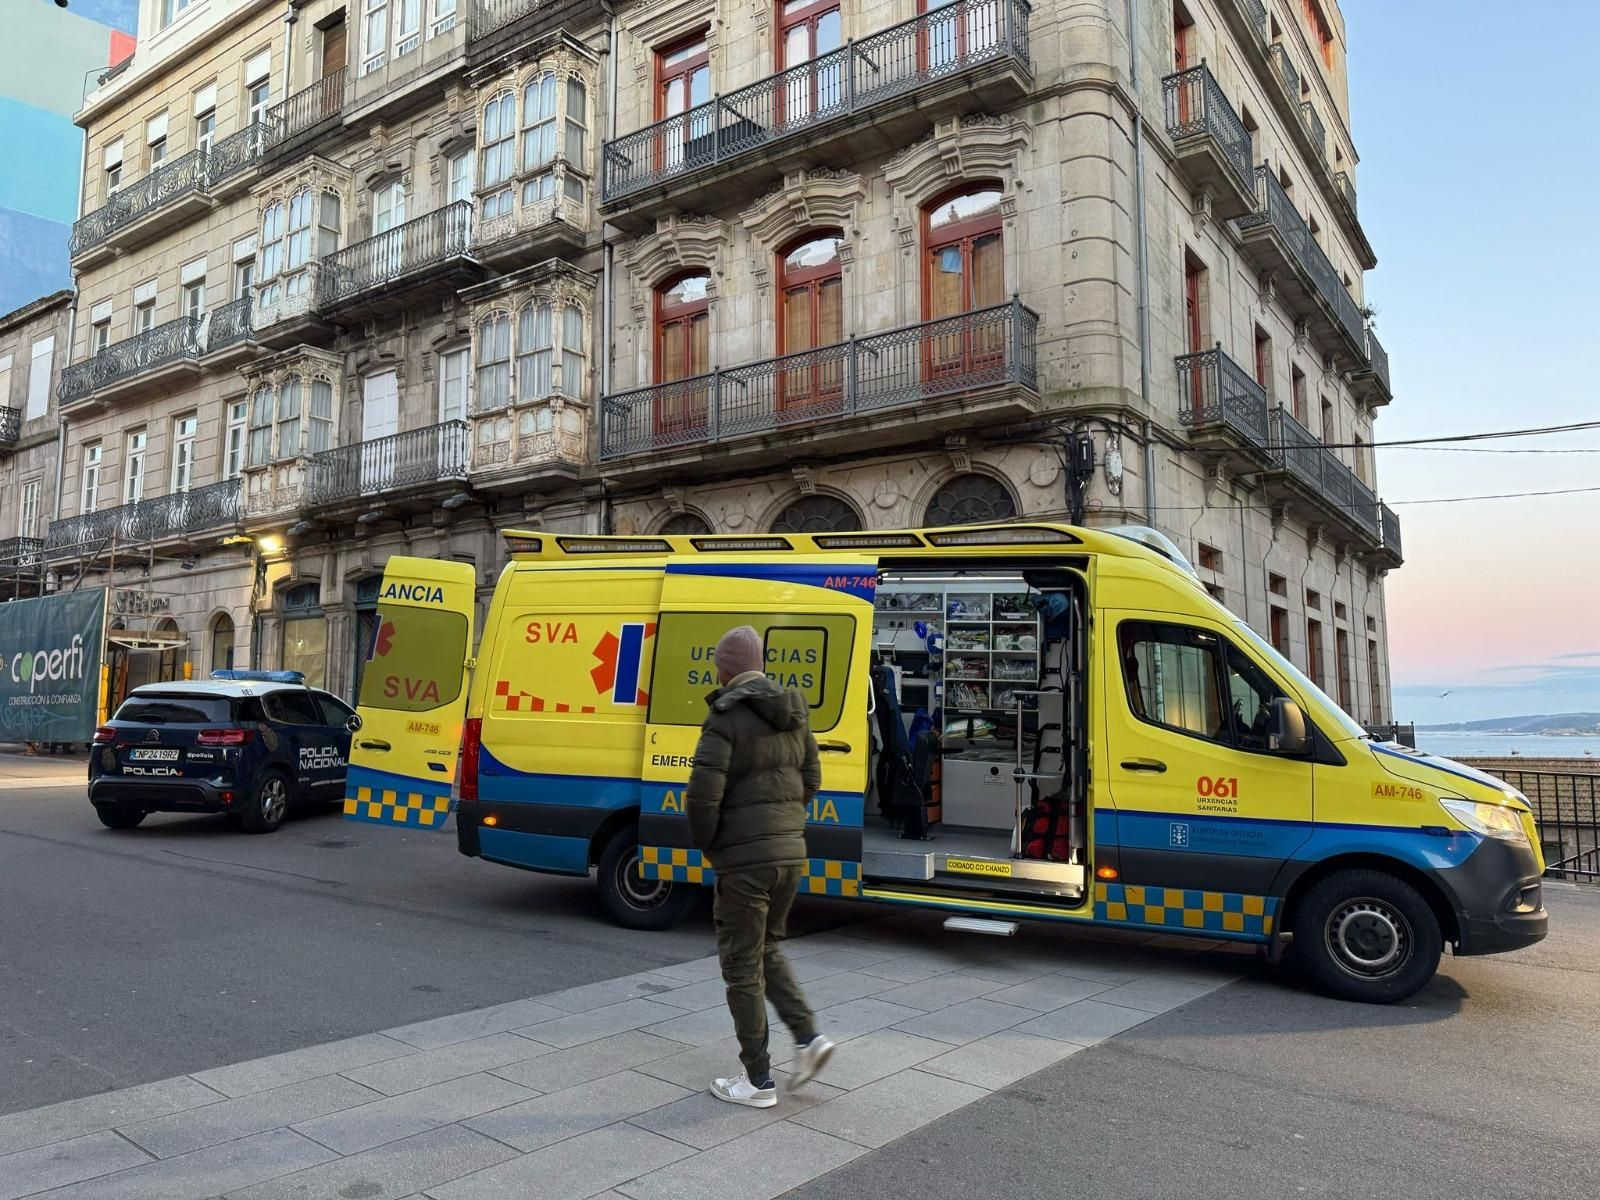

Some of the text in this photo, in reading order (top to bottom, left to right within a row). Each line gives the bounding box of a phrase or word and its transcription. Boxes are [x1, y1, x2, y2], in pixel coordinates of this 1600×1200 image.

[823, 576, 877, 588] AM-746
[379, 583, 443, 603] ANCIA
[525, 622, 578, 643] SVA
[12, 634, 83, 693] coperfi
[384, 675, 440, 703] SVA
[8, 695, 46, 706] CONSTRUCCIÓN
[51, 694, 82, 705] CONFIANZA
[409, 722, 439, 735] AM-746
[299, 757, 348, 770] NACIONAL
[123, 766, 179, 776] POLICÍA
[1197, 776, 1238, 798] 061
[1374, 784, 1423, 800] AM-746
[1197, 805, 1238, 813] SANITARIAS
[948, 861, 974, 870] COIDADO
[985, 865, 1010, 873] CHANZO
